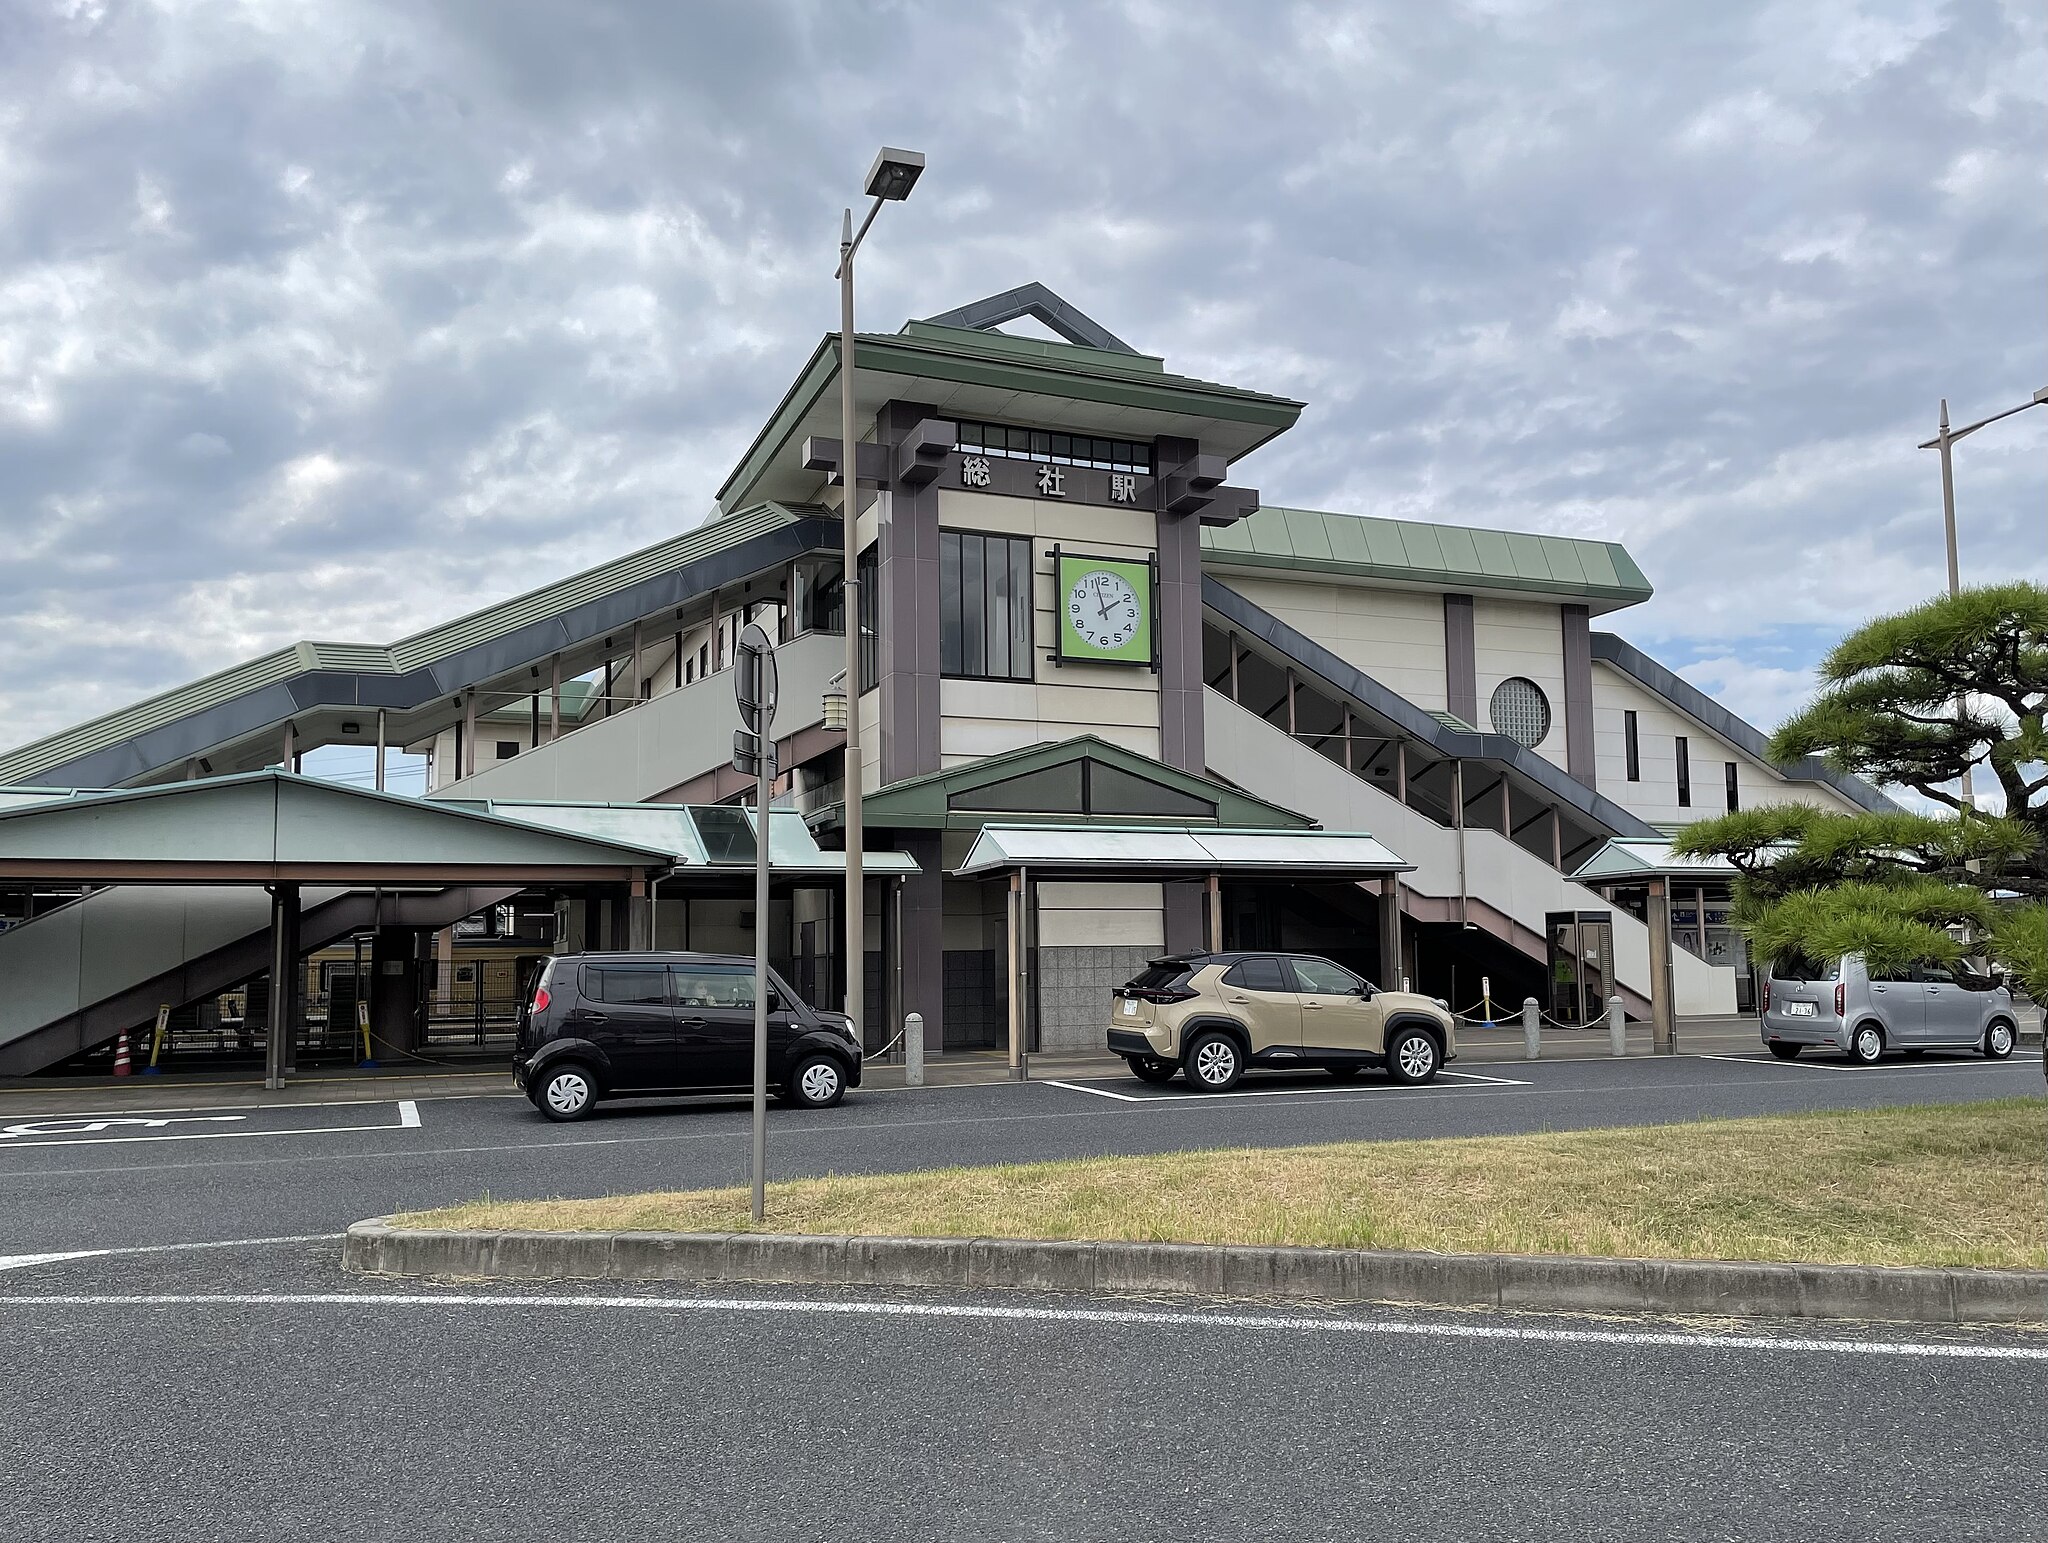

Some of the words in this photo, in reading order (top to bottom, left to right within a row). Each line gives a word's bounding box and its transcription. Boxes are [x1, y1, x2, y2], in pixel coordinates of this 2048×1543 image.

[963, 456, 1137, 503] 総社駅
[1083, 579, 1094, 589] 11
[1097, 576, 1110, 587] 12
[1115, 581, 1119, 591] 1
[1074, 589, 1087, 599] 10
[1123, 593, 1132, 603] 2
[1071, 604, 1080, 613] 9
[1127, 608, 1136, 618] 3
[1075, 619, 1084, 629] 8
[1123, 623, 1132, 632] 4
[1086, 631, 1095, 640] 7
[1100, 636, 1109, 645] 6
[1113, 633, 1122, 643] 5
